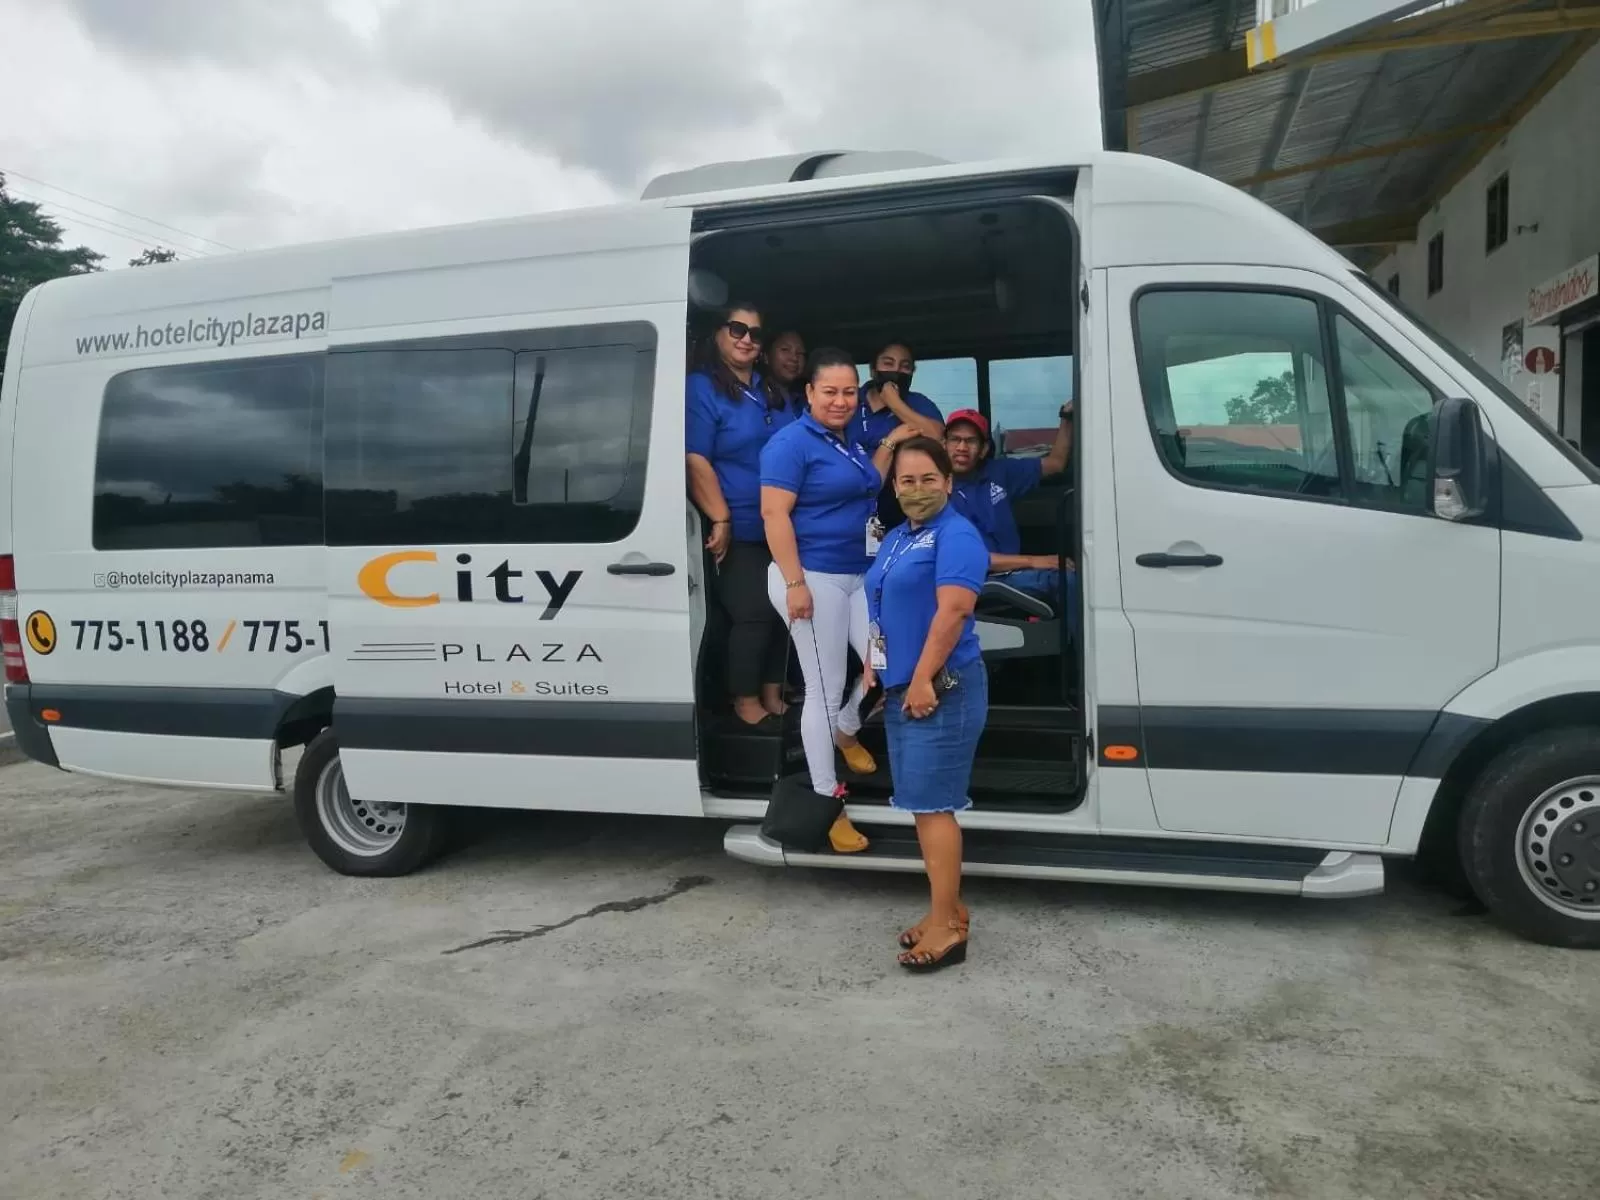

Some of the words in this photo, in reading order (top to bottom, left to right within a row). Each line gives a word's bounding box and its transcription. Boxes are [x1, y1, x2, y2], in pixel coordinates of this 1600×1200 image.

[76, 311, 325, 354] www.hotelcityplazapa
[107, 570, 274, 588] @hotelcityplazapanama
[357, 550, 584, 621] City
[71, 620, 209, 651] 775-1188
[243, 620, 330, 652] 775-1
[442, 643, 603, 662] PLAZA
[444, 681, 502, 695] Hotel
[510, 681, 526, 695] &
[535, 681, 609, 696] Suites
